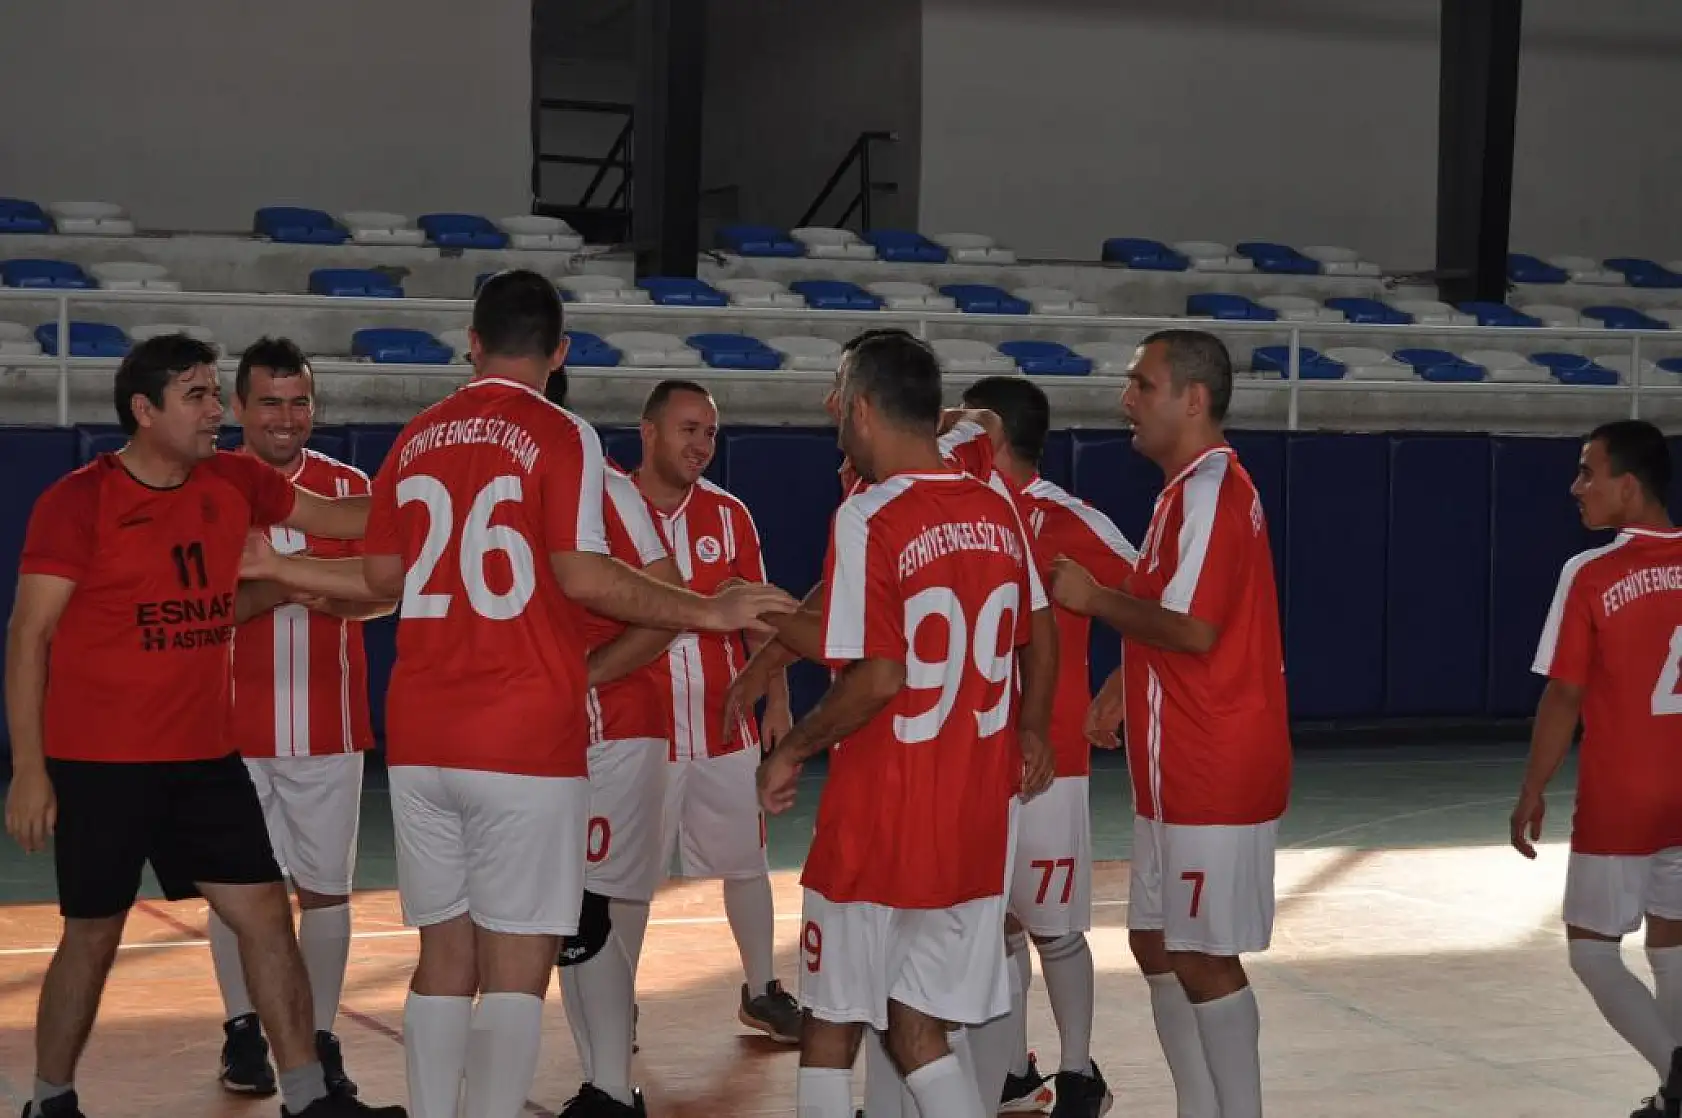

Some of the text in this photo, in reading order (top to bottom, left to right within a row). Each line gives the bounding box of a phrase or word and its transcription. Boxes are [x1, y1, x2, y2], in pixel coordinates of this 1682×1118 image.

[171, 542, 207, 589] 11
[395, 474, 537, 621] 26
[135, 593, 233, 627] ESNAF
[892, 581, 1020, 744] 99
[1030, 857, 1075, 904] 77
[1180, 871, 1205, 918] 7
